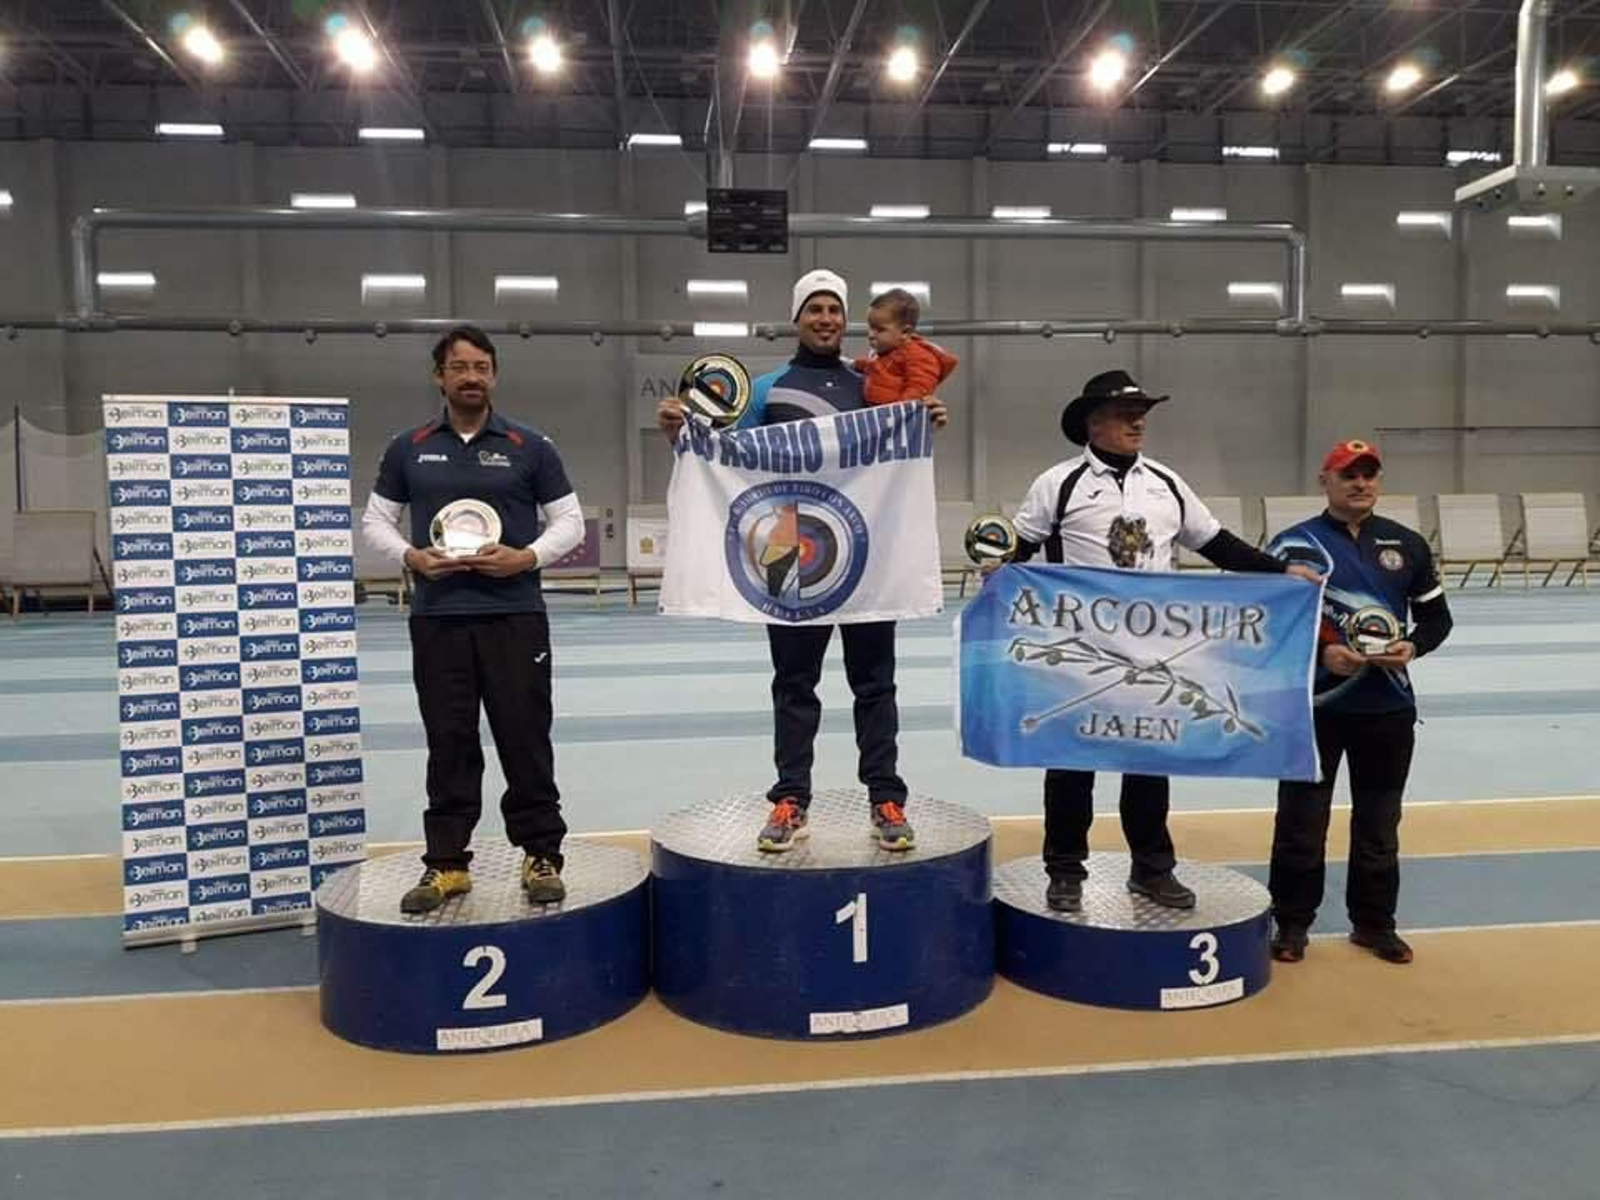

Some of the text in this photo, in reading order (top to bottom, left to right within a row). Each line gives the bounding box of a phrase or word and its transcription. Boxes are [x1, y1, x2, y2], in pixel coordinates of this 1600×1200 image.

[720, 421, 823, 474] ASIRIO
[1009, 587, 1267, 645] ARCOSUR
[1080, 713, 1181, 741] JAEN
[835, 892, 868, 963] 1
[462, 945, 507, 1010] 2
[1188, 932, 1220, 985] 3
